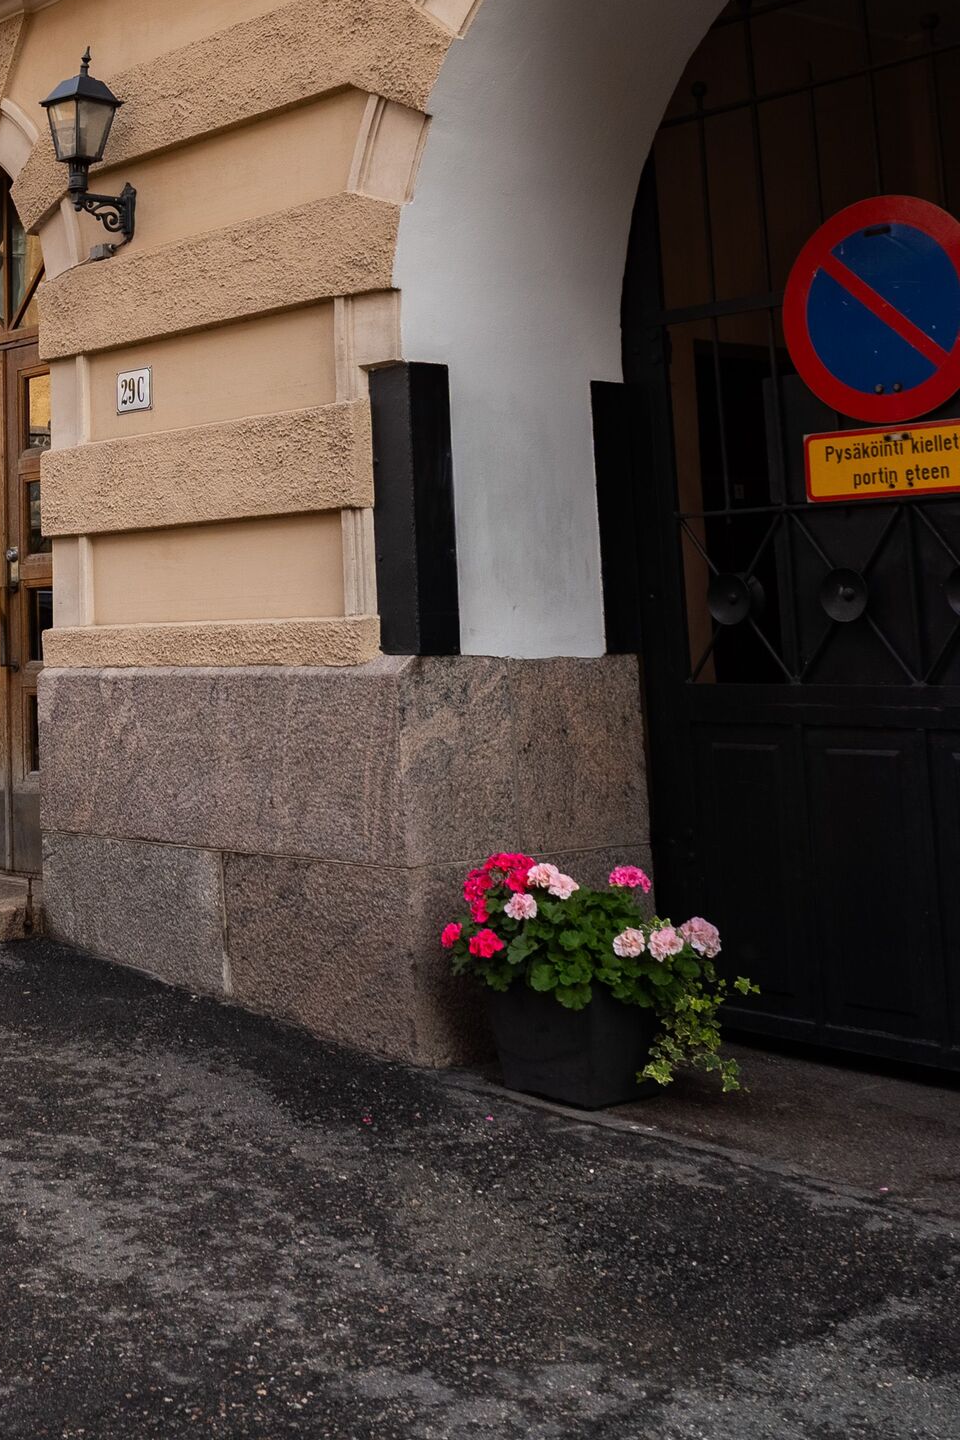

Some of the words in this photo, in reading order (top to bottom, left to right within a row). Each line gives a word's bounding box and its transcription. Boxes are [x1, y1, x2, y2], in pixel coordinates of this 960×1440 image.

[825, 440, 904, 464] Pysäköinti
[911, 432, 960, 454] kiellet
[853, 467, 898, 489] portin
[905, 464, 950, 482] eteen
